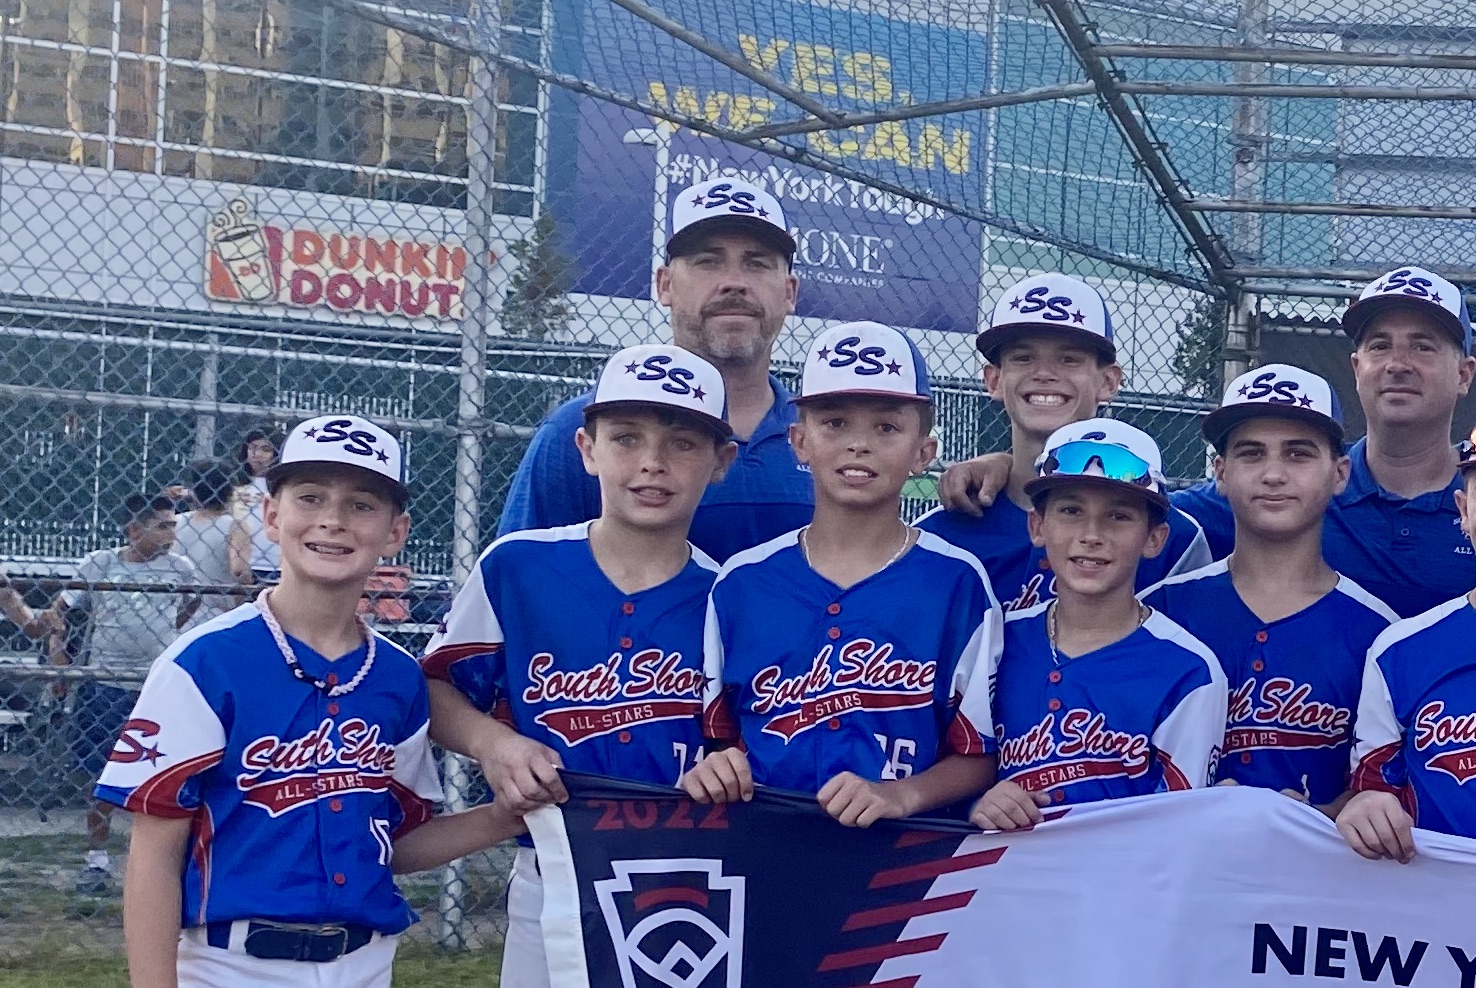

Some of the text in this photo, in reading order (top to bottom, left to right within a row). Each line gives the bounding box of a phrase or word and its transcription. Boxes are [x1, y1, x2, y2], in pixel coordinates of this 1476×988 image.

[806, 116, 971, 175] CAN
[705, 183, 756, 213] SS
[290, 269, 464, 316] DONUT
[1385, 270, 1432, 297] SS
[1020, 286, 1073, 322] SS
[637, 355, 695, 395] SS
[828, 336, 888, 377] SS
[1247, 372, 1299, 405] SS
[316, 420, 377, 457] SS
[523, 649, 704, 704] South Shor
[833, 638, 937, 691] Shore
[569, 705, 654, 732] ALL-STARS
[1253, 677, 1350, 736] Shore
[1057, 708, 1150, 764] Shore
[583, 799, 730, 831] 2022
[1251, 922, 1428, 987] NEW
